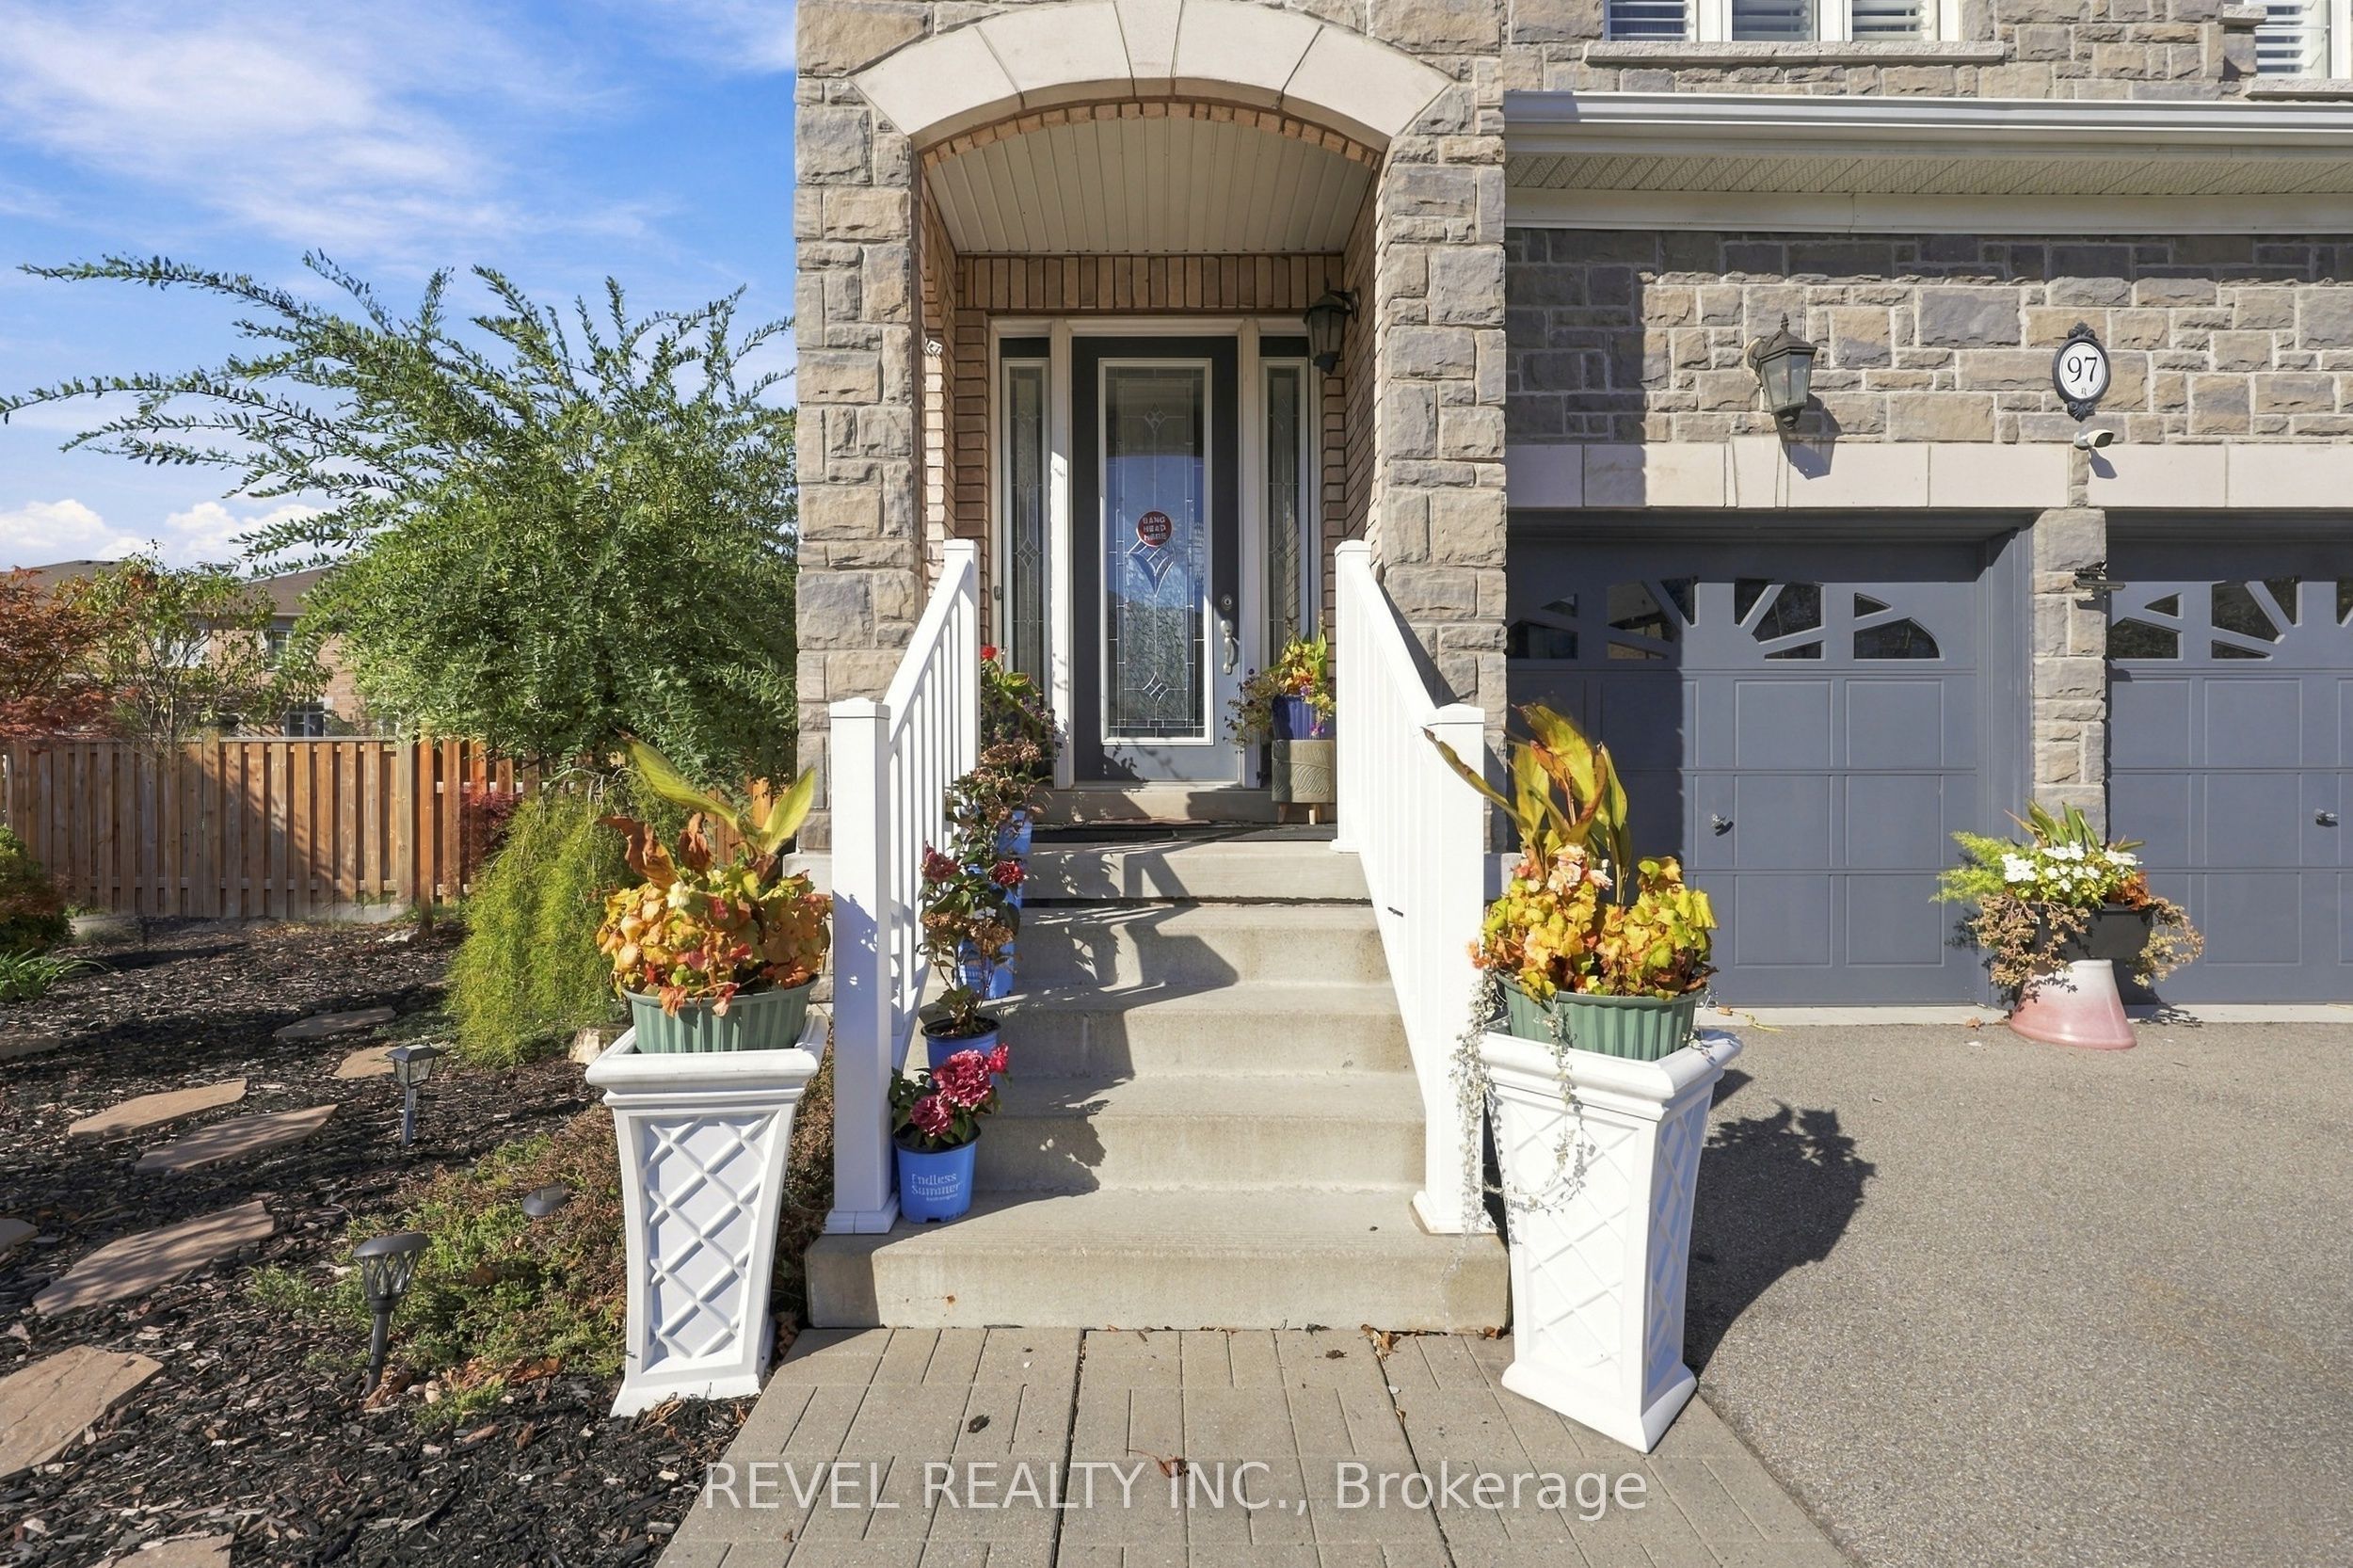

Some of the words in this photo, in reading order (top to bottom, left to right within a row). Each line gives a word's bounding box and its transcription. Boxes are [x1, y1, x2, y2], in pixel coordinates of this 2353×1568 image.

[2067, 356, 2098, 383] 97
[1143, 516, 1165, 524] BANG
[1143, 524, 1166, 533] HEAD
[1144, 532, 1166, 541] HERE
[911, 1173, 957, 1185] Endless
[911, 1182, 961, 1196] Summer
